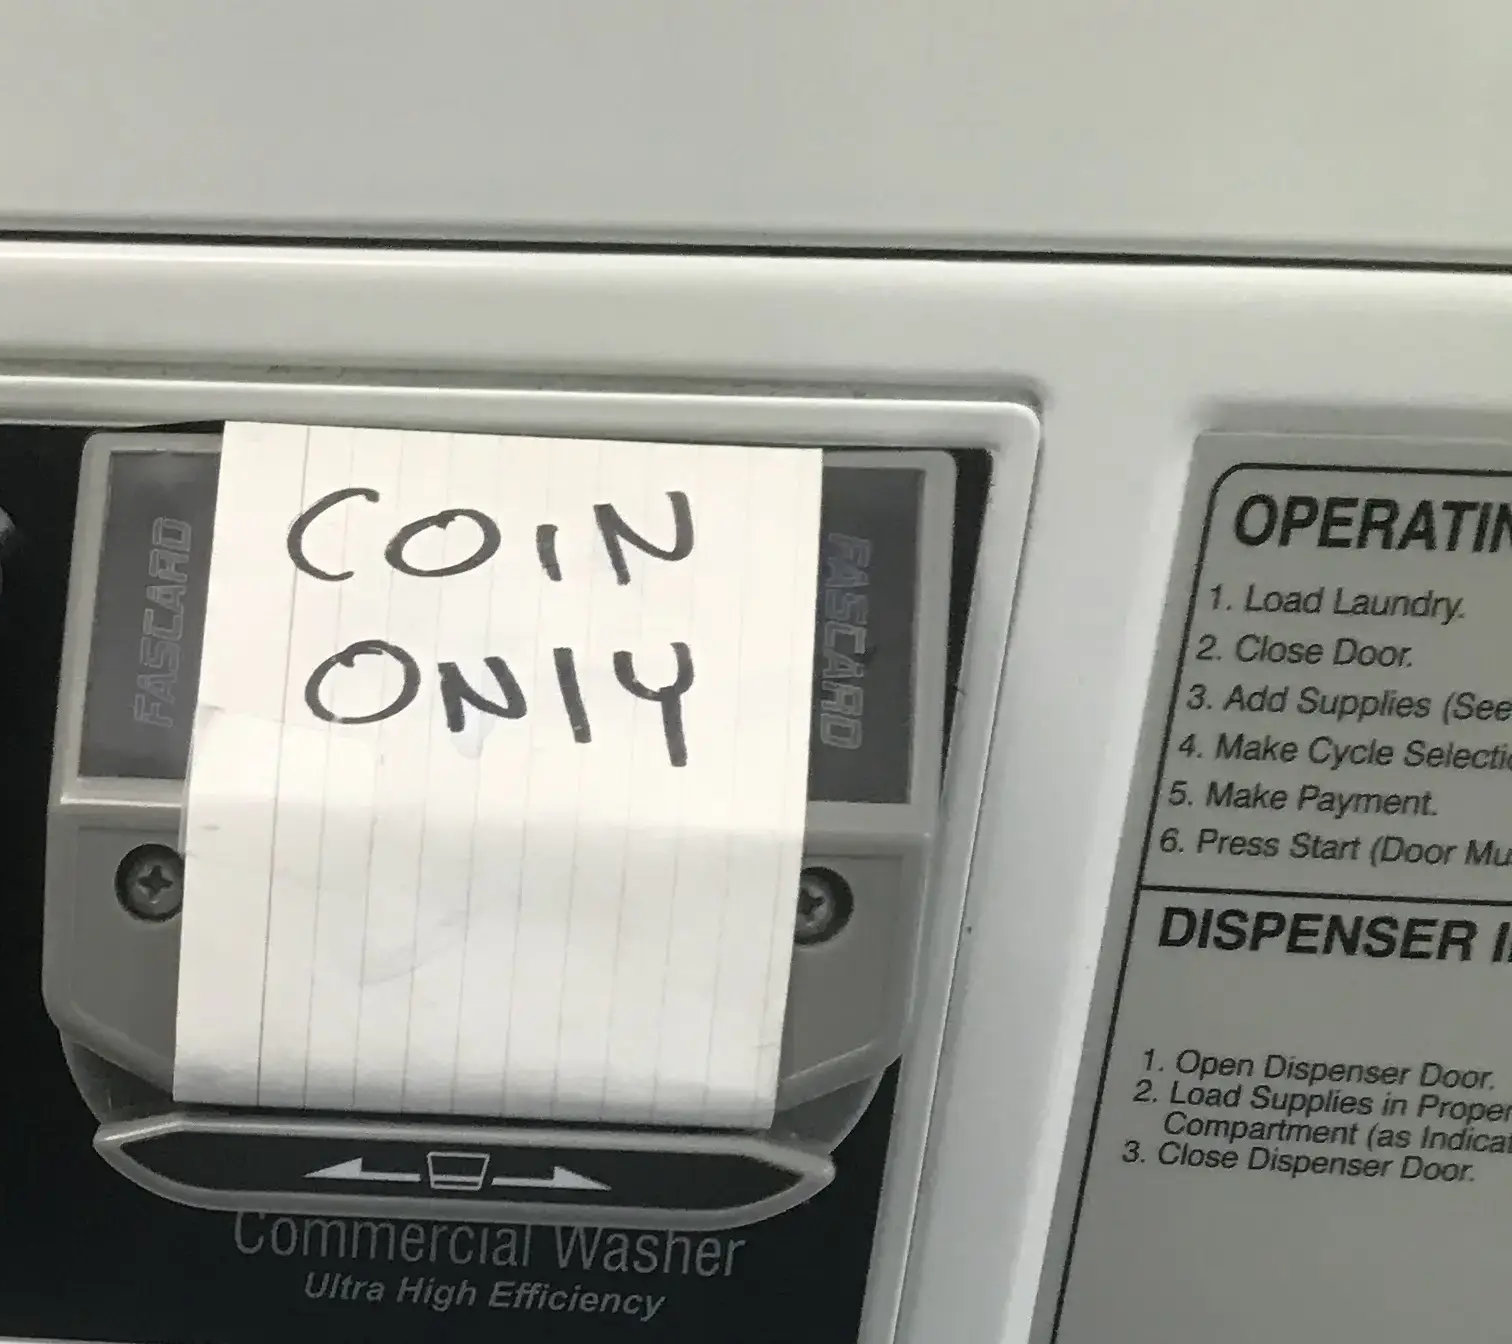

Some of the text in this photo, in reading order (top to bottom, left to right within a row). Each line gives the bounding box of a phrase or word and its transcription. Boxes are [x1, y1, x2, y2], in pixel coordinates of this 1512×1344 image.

[289, 487, 696, 585] COIN
[134, 517, 191, 727] FASCARD
[1211, 584, 1466, 625] 1. Load Laundry.
[820, 533, 872, 749] FASCARD
[1196, 634, 1413, 668] 2. Close Door.
[1187, 684, 1213, 711] 3.
[1223, 685, 1289, 713] Add
[1297, 687, 1432, 723] Supplies
[1179, 734, 1202, 759] 4.
[1215, 733, 1299, 763] Make
[1309, 736, 1394, 771] Cycle
[1169, 781, 1438, 819] 5. Make Payment.
[1159, 828, 1185, 853] 6.
[1197, 829, 1281, 857] Press
[1289, 832, 1361, 860] Start
[1370, 835, 1457, 867] (Door
[1159, 906, 1479, 961] DISPENSER
[1143, 1048, 1496, 1090] 1. Open Dispenser Door.
[1133, 1079, 1157, 1103] 2.
[1170, 1080, 1243, 1108] Load
[1250, 1084, 1373, 1117] Supplies
[1383, 1091, 1408, 1117] in
[1164, 1111, 1359, 1145] Compartment
[1367, 1123, 1412, 1152] (as
[1122, 1140, 1476, 1182] 3. Close Dispenser Door.
[554, 1226, 746, 1277] Washer
[304, 1272, 666, 1322] Ultra High Efficiency
